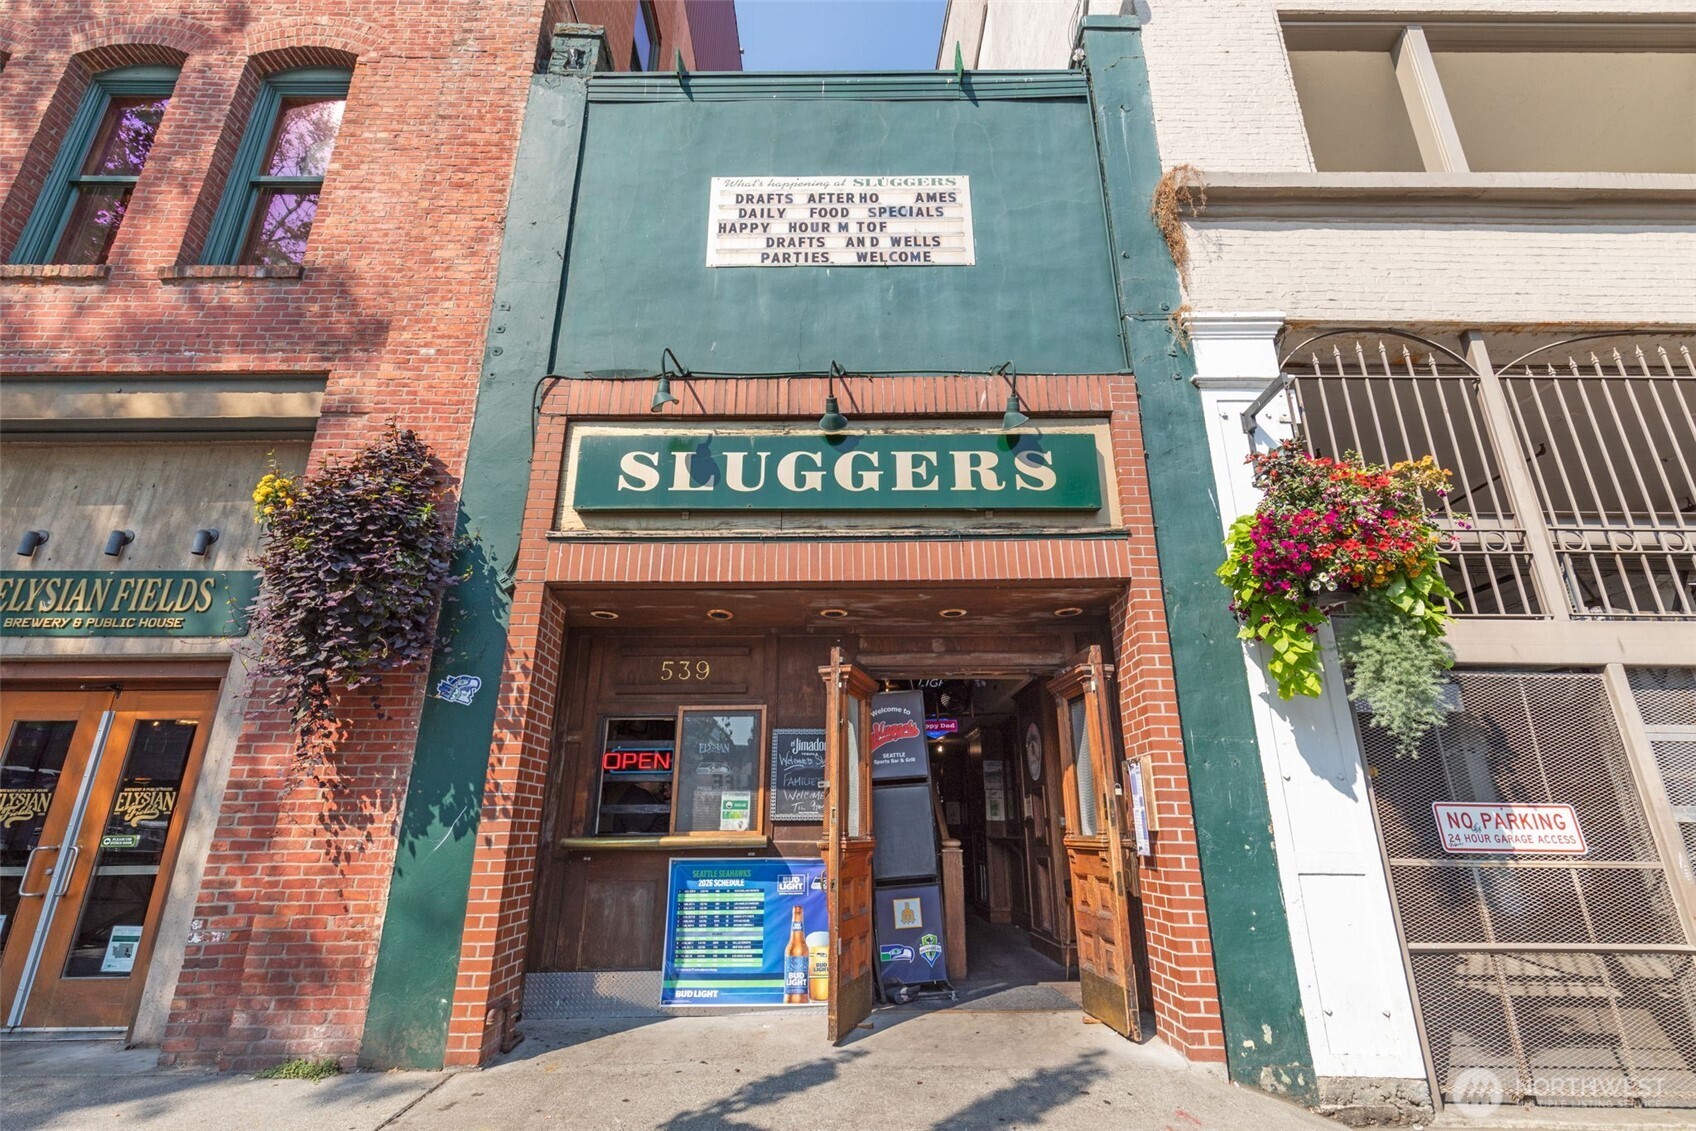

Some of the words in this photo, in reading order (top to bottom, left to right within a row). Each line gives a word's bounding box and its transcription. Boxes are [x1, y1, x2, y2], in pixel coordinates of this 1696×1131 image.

[724, 179, 764, 188] What's
[767, 179, 831, 190] happening
[834, 179, 846, 187] at
[853, 177, 956, 187] SLUGGERS
[736, 193, 793, 204] DRAFTS
[807, 192, 854, 204] AFTER
[916, 192, 956, 203] AMES
[739, 207, 786, 219] DAILY
[810, 207, 849, 219] FOOD
[868, 205, 944, 218] SPECIALS
[718, 222, 770, 234] HAPPY
[789, 221, 830, 233] HOUR
[766, 236, 825, 248] DRAFTS
[846, 236, 879, 248] AND
[890, 235, 941, 247] WELLS
[761, 251, 829, 263] PARTIES
[857, 251, 931, 262] WELCOME
[617, 451, 1057, 492] SLUGGERS
[0, 577, 112, 612] ELYSIAN
[111, 577, 215, 612] FIELDS
[4, 617, 70, 629] BREWERY
[72, 617, 82, 629] &
[85, 617, 136, 629] PUBLIC
[138, 617, 185, 629] HOUSE
[660, 660, 710, 681] 539
[871, 706, 902, 718] Welcome
[903, 707, 911, 716] to
[940, 722, 956, 730] Dad
[698, 742, 730, 754] ELYSIAN
[603, 752, 671, 770] OPEN
[874, 758, 890, 766] Sports
[0, 793, 52, 812] LYSIAN
[114, 791, 176, 812] ELYSIAN
[1446, 811, 1473, 829] NO
[1480, 812, 1567, 831] PARKING
[1448, 833, 1461, 843] 24
[1464, 833, 1491, 844] HOUR
[1494, 833, 1534, 844] GARAGE
[1538, 834, 1577, 845] ACCESS
[692, 869, 717, 878] SEATTLE
[718, 869, 752, 878] SEAHAWKS
[713, 879, 745, 887] SCHEDULE
[783, 876, 800, 884] BUD
[785, 978, 808, 986] LIGHT
[675, 990, 694, 998] BUD
[694, 990, 719, 998] LIGHT
